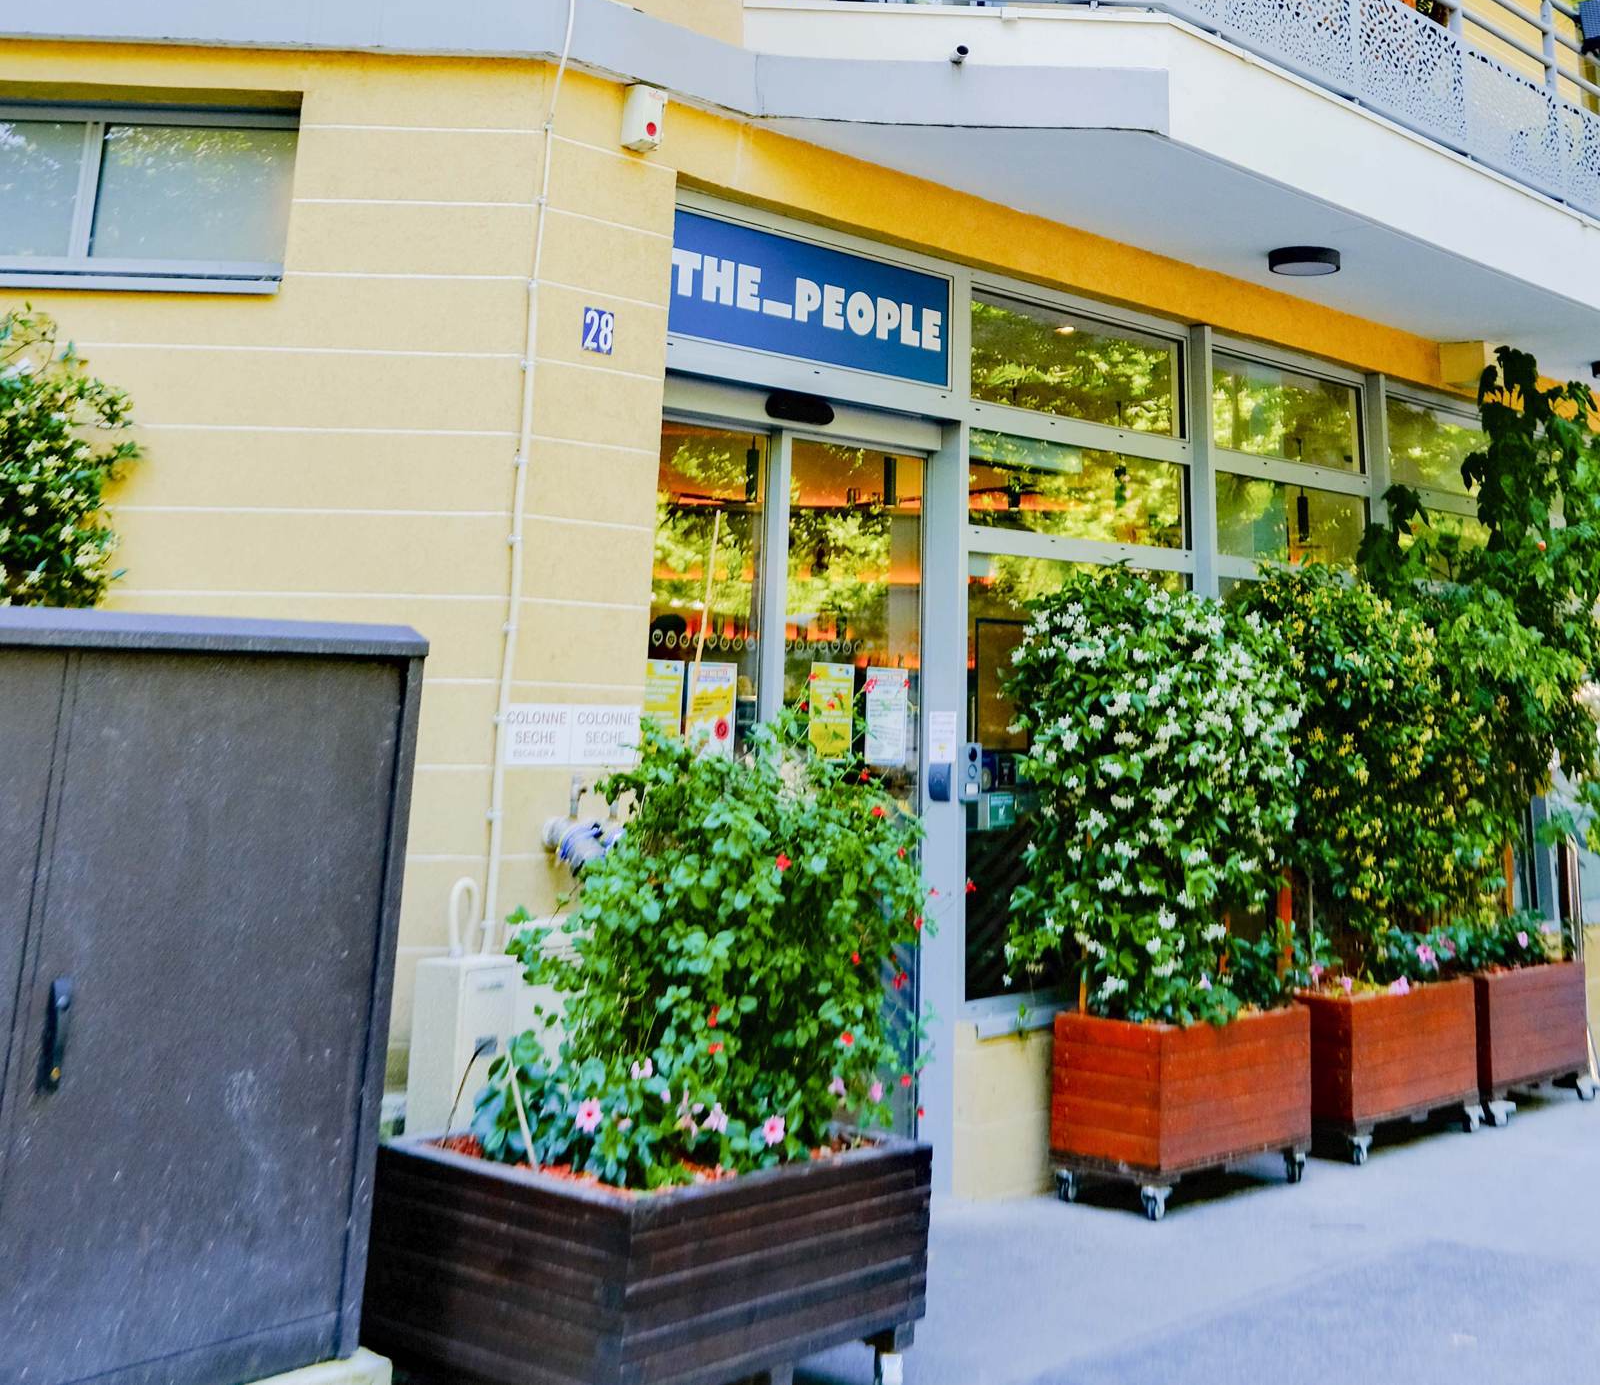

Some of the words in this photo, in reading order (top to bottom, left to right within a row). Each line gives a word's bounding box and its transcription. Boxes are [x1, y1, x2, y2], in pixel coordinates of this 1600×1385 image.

[584, 310, 614, 352] 28
[507, 711, 567, 725] COLONNE
[577, 711, 635, 725] COLONNE
[515, 730, 556, 744] SECHE
[585, 731, 625, 744] SECHE
